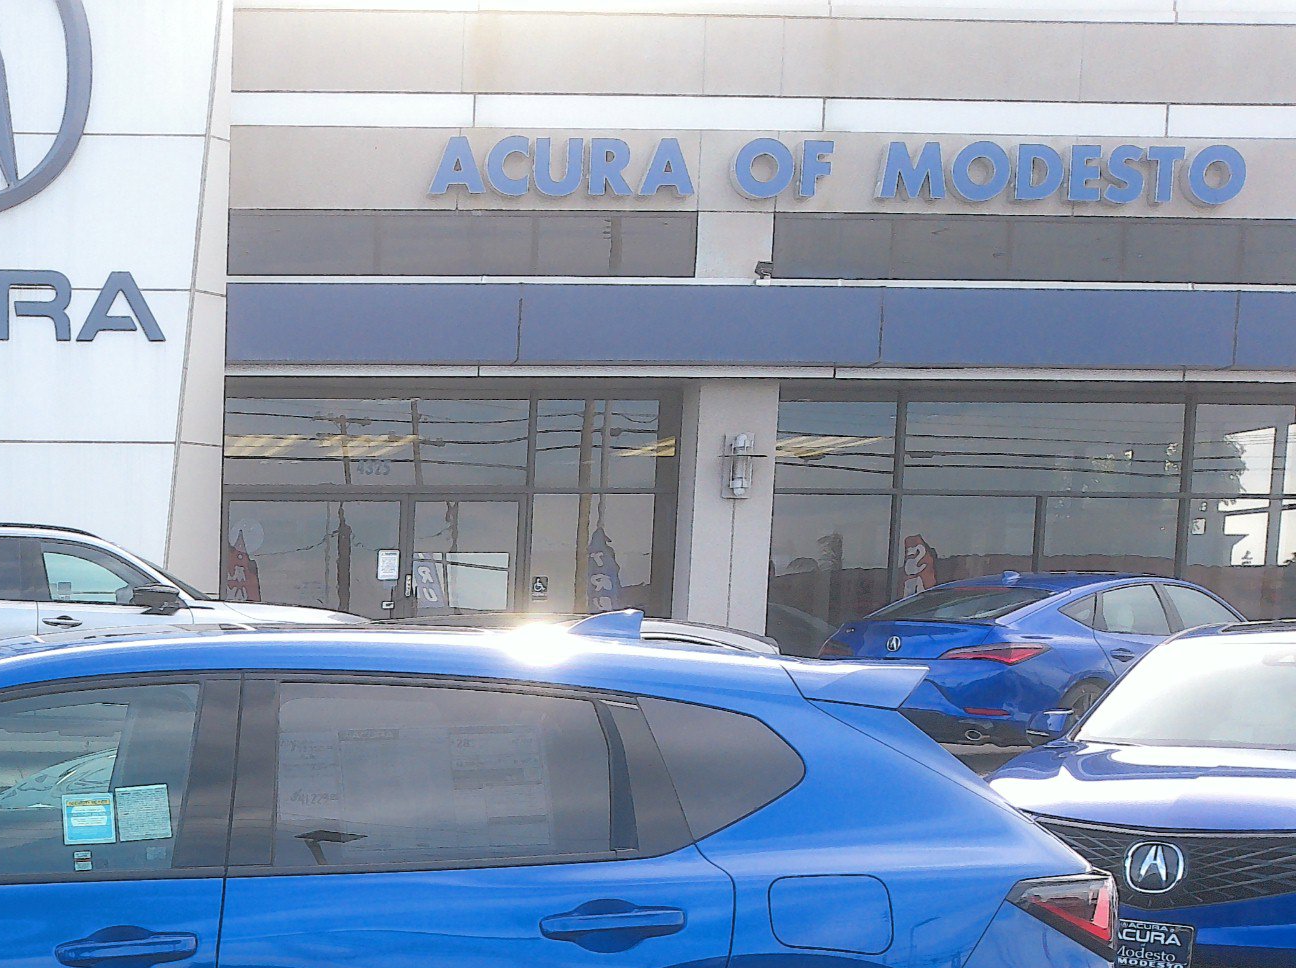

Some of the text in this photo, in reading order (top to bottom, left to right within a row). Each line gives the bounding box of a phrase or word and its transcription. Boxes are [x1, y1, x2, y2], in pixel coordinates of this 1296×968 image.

[427, 136, 1247, 205] ACURA OF MODESTO
